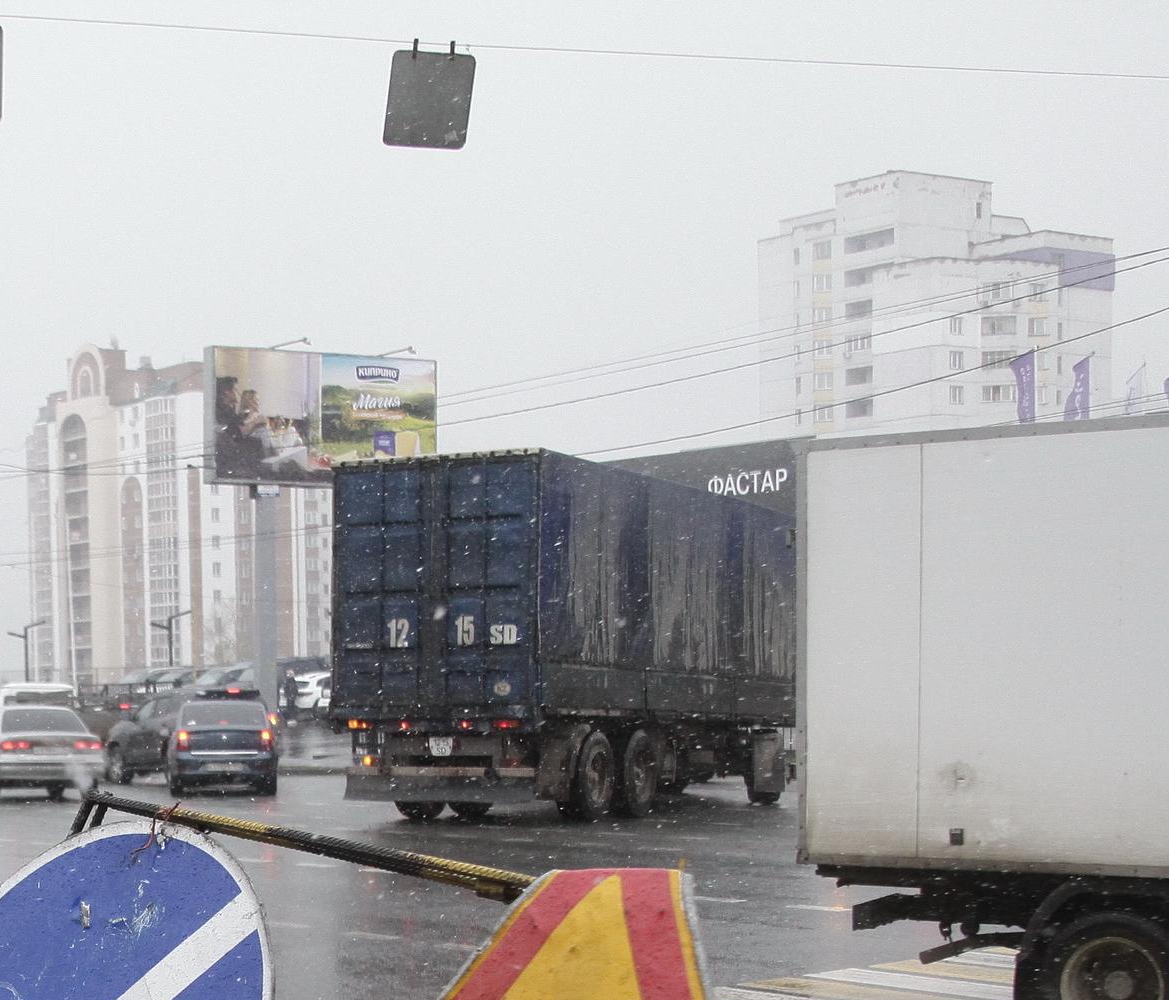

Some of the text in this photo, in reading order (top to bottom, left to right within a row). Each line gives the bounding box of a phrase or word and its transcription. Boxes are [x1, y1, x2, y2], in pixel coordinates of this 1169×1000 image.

[708, 468, 787, 496] ФАСТАР
[387, 615, 518, 648] 12 15 SD
